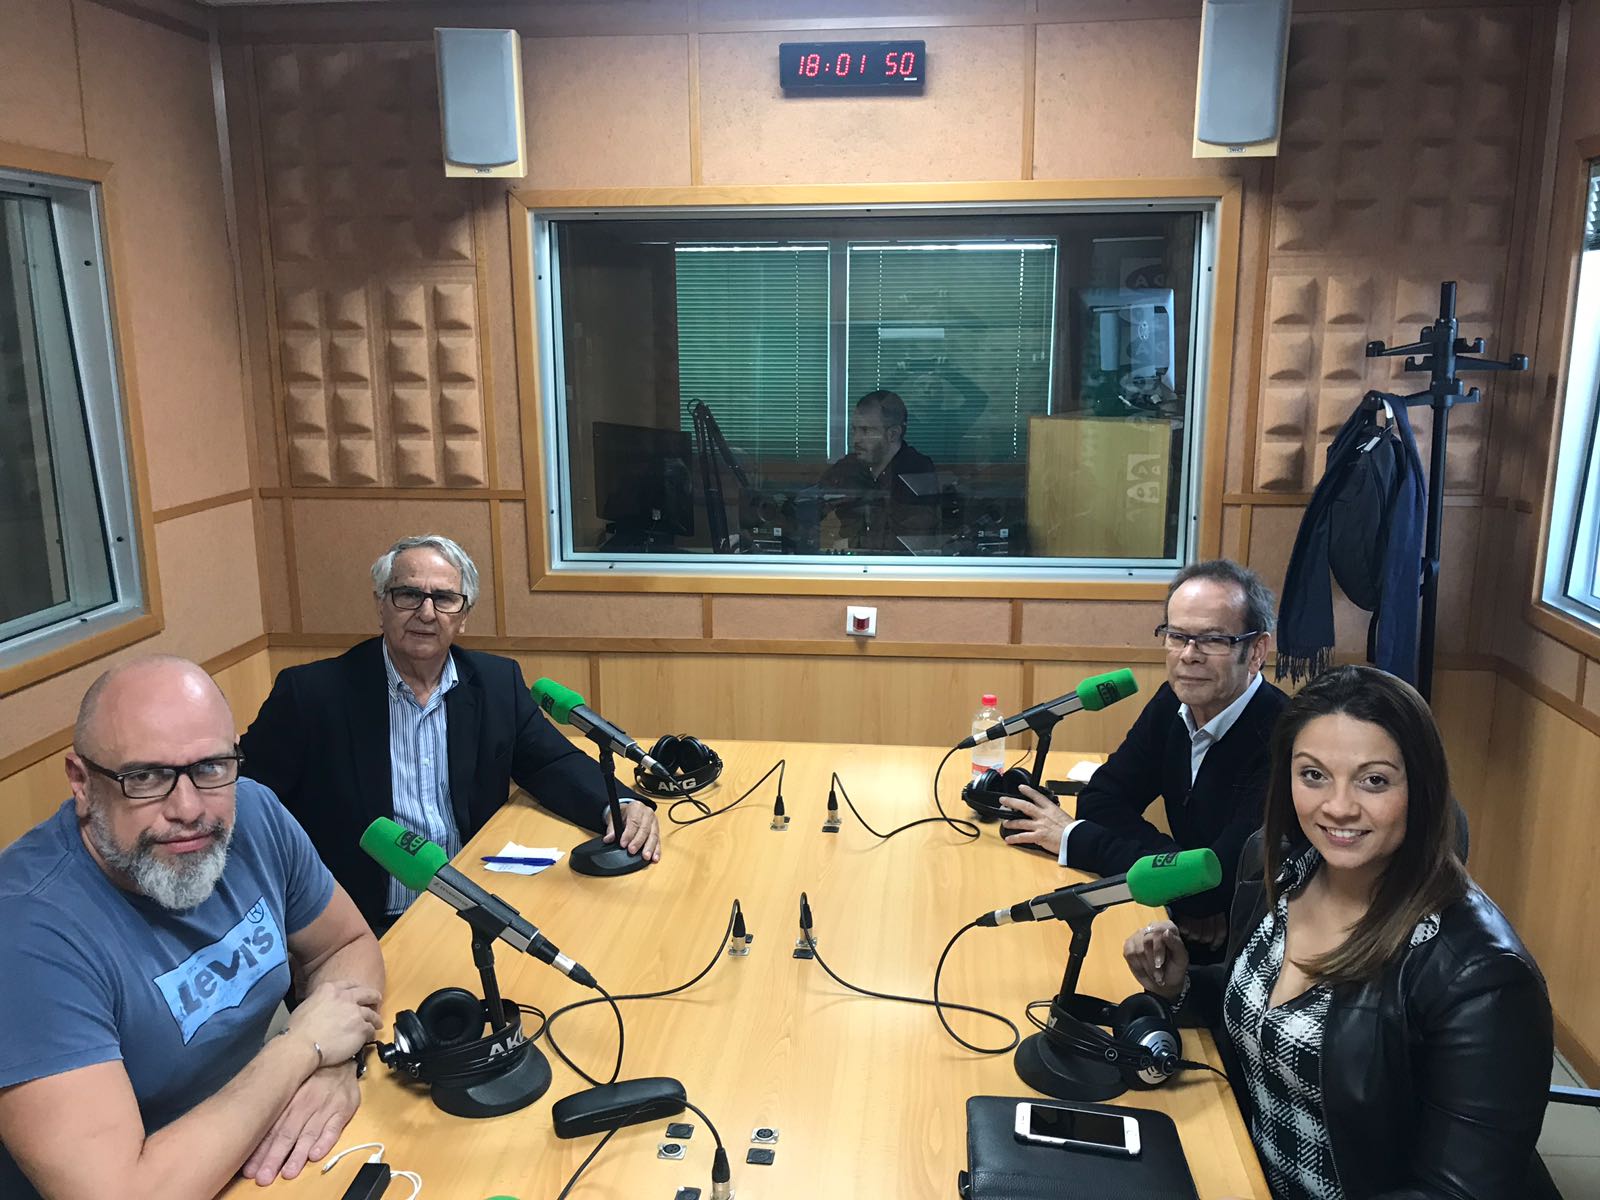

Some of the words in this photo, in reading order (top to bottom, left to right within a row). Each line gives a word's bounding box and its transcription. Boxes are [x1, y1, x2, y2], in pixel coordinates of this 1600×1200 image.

[798, 53, 866, 77] 18:01
[885, 51, 915, 75] 50
[658, 777, 697, 792] AKG
